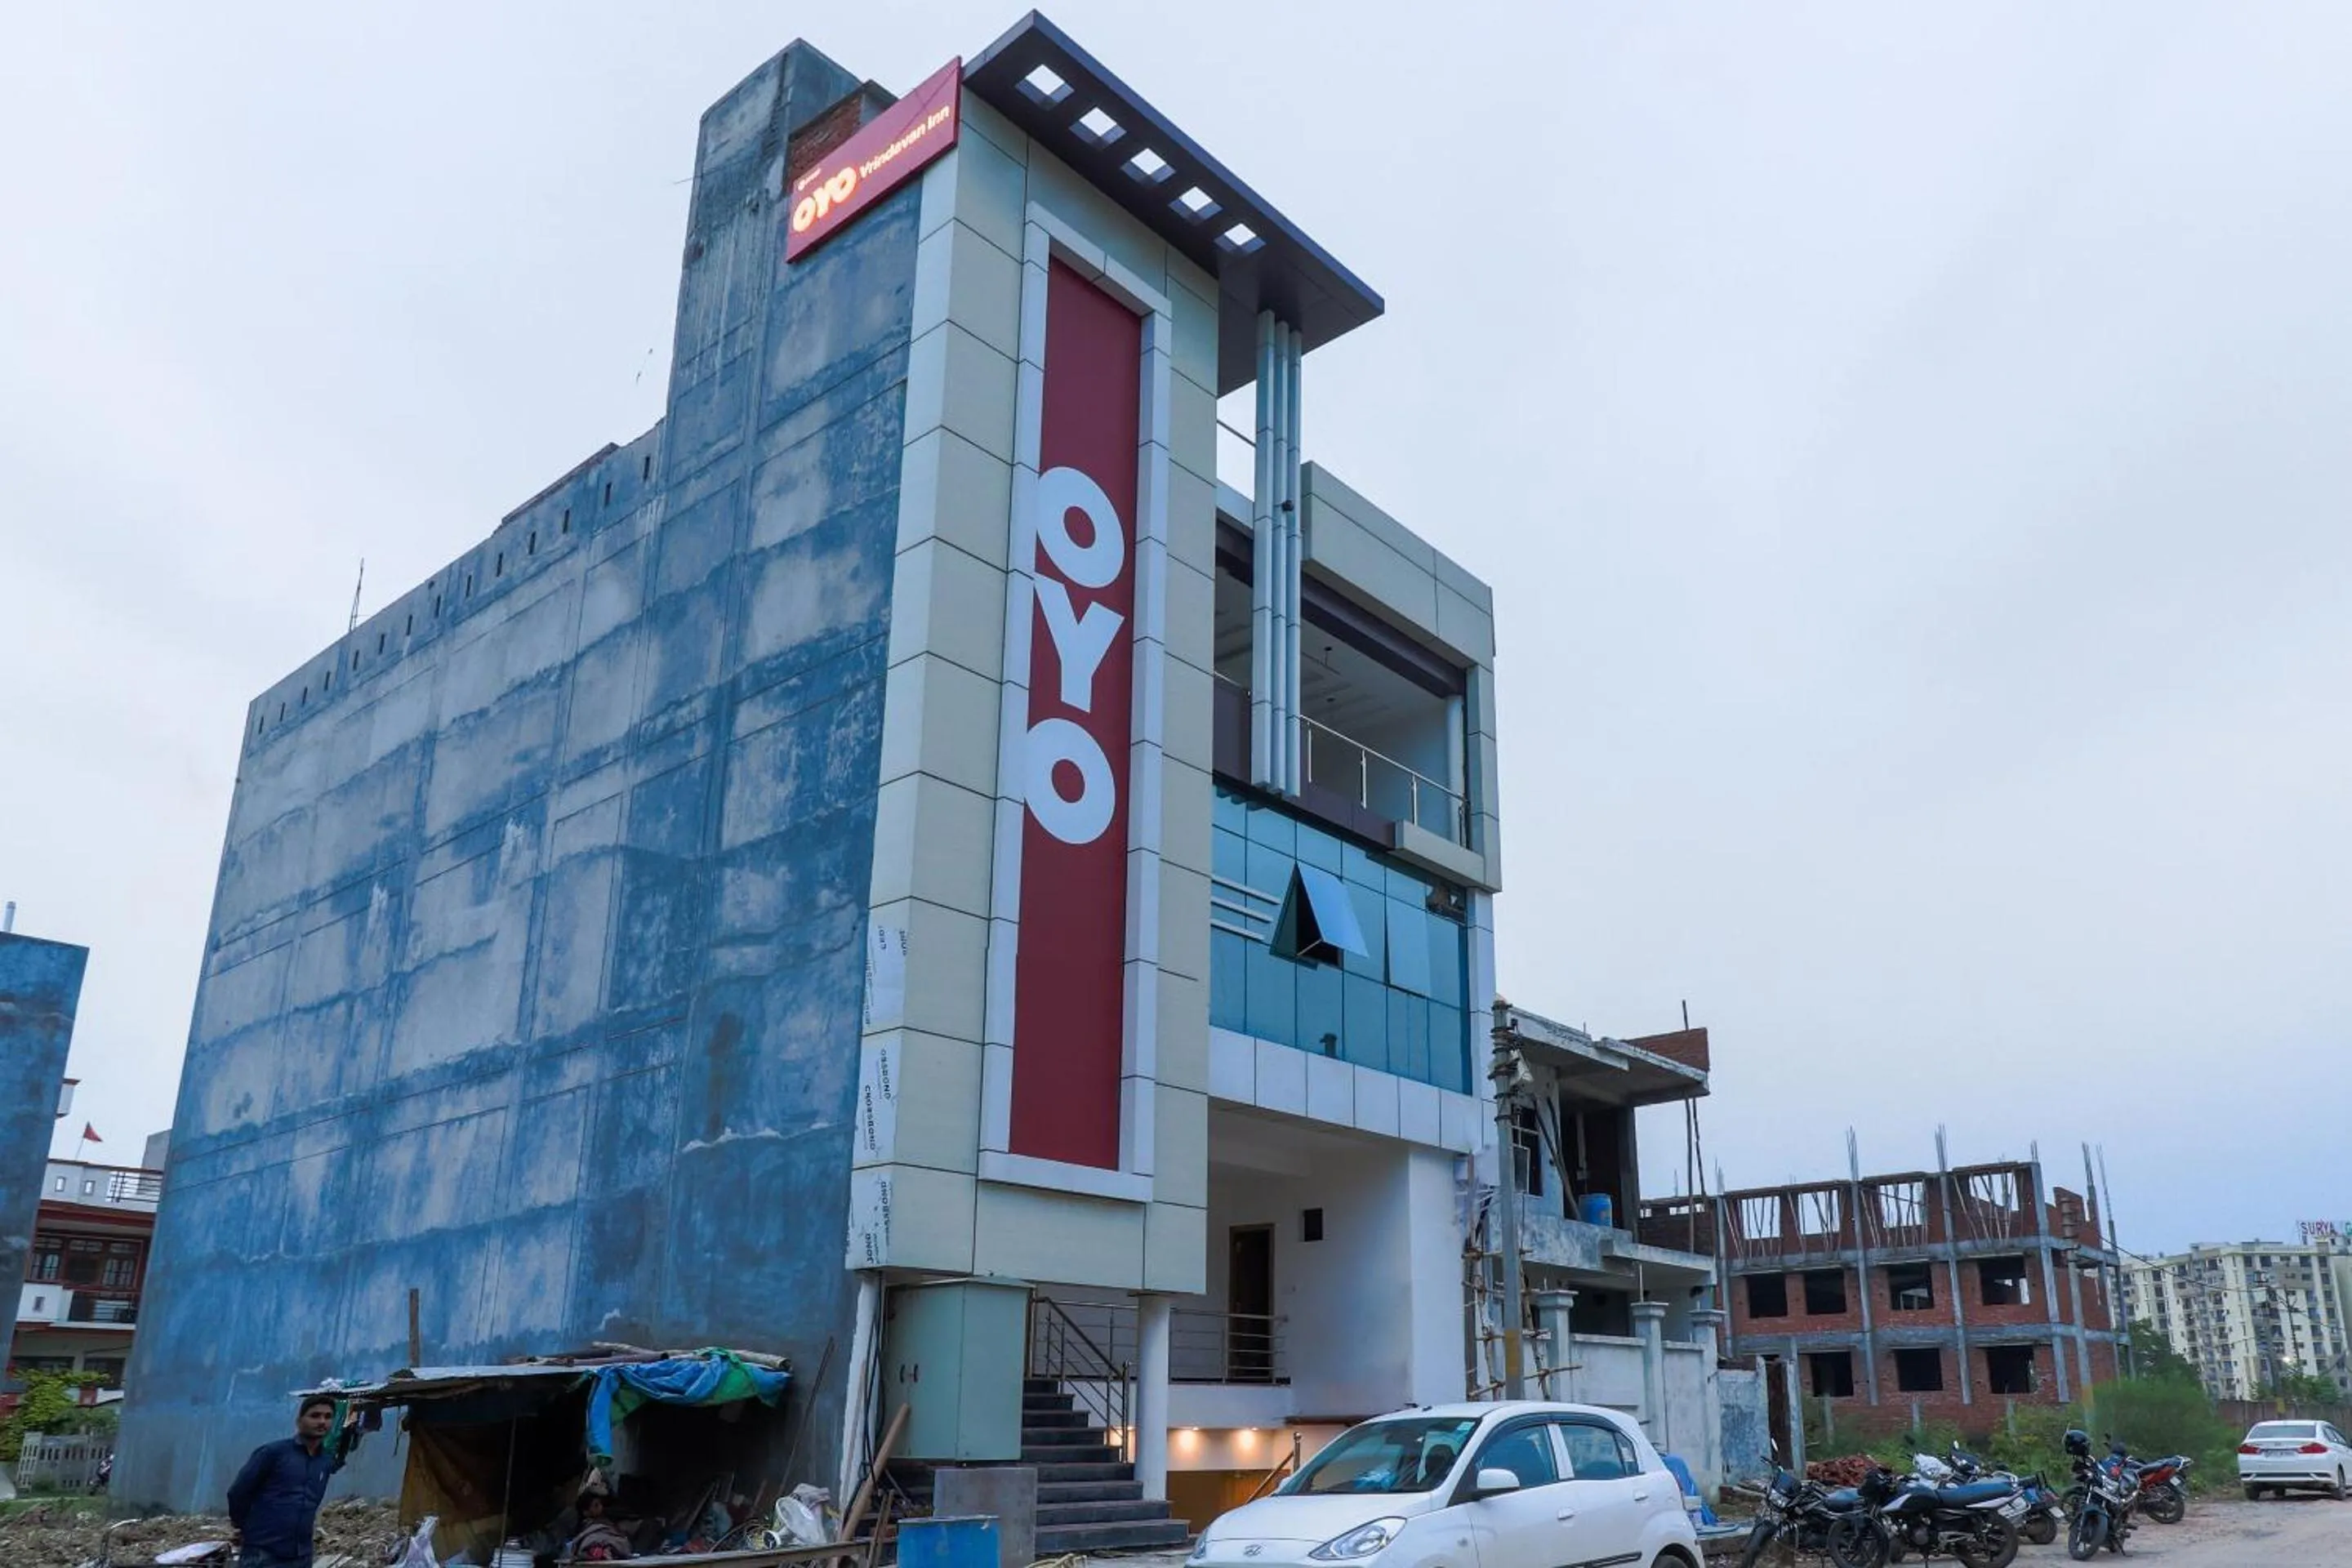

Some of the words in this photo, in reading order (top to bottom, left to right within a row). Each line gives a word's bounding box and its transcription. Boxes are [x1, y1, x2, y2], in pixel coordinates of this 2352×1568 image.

[793, 167, 857, 231] OYO
[859, 123, 926, 178] Vrindavan
[928, 105, 950, 130] Inn
[1023, 466, 1125, 844] OYO
[2300, 1221, 2337, 1236] SURYA
